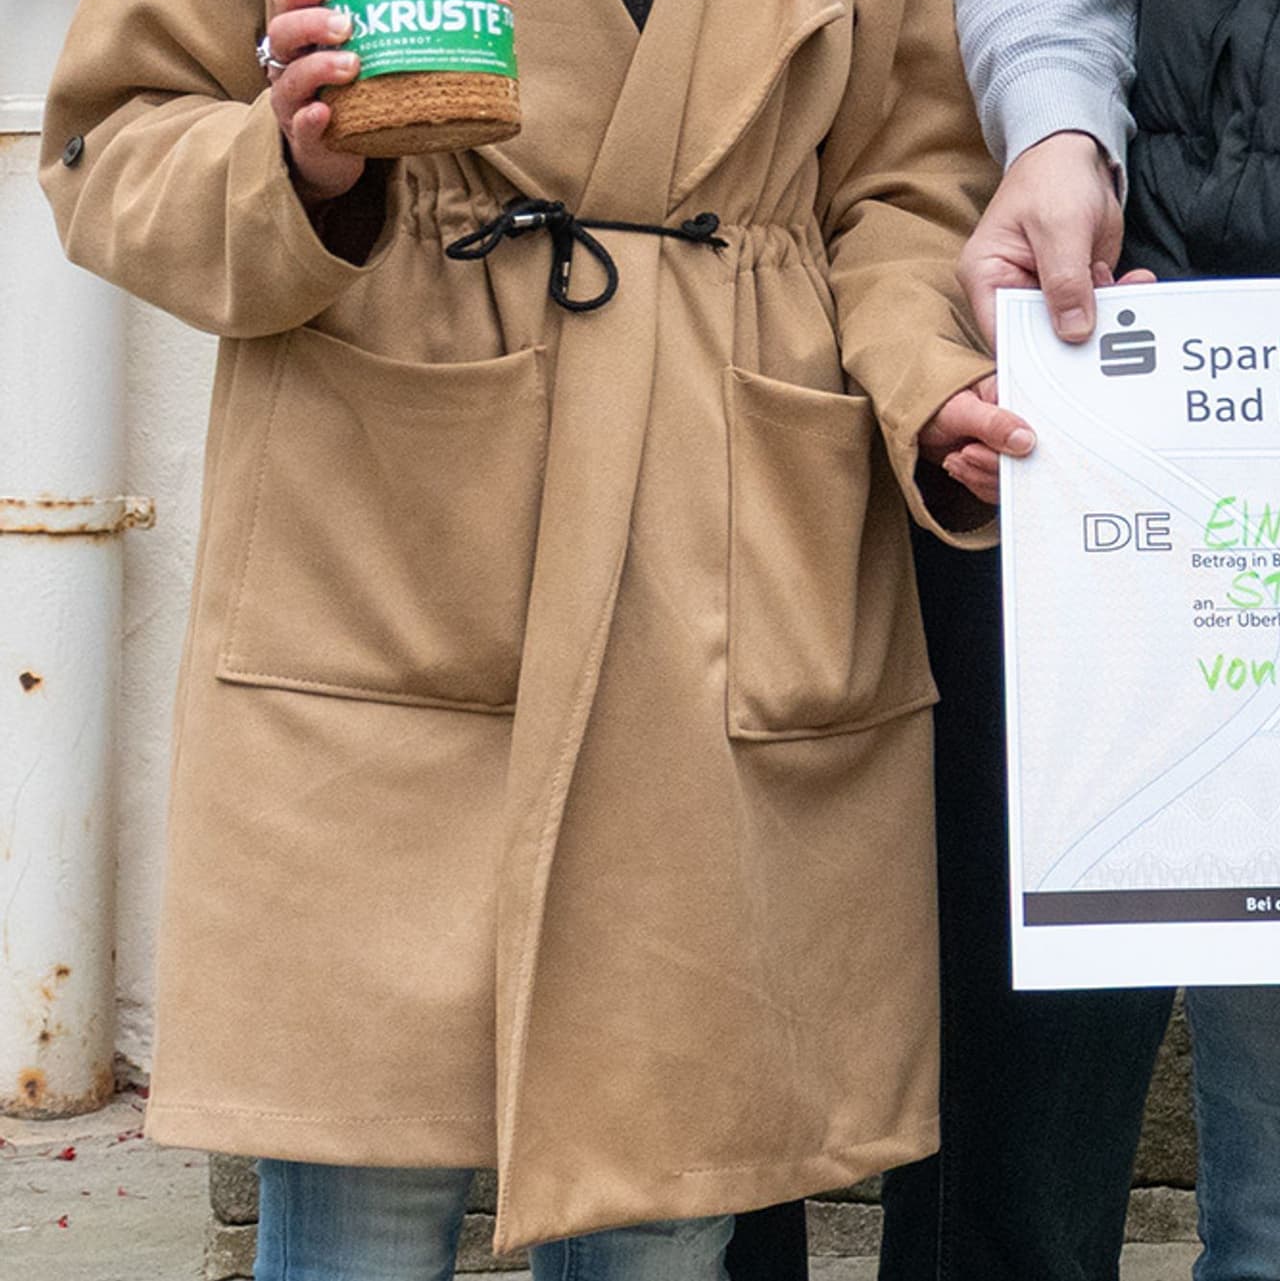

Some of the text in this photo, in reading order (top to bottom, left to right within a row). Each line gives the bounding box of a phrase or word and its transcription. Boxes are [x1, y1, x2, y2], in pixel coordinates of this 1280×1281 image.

[1186, 387, 1263, 422] Bad
[1083, 512, 1173, 553] DE
[1192, 553, 1247, 571] Betrag
[1252, 554, 1267, 567] in
[1193, 599, 1214, 611] an
[1193, 613, 1231, 628] oder
[1199, 654, 1276, 690] von
[1246, 895, 1272, 911] Bei
